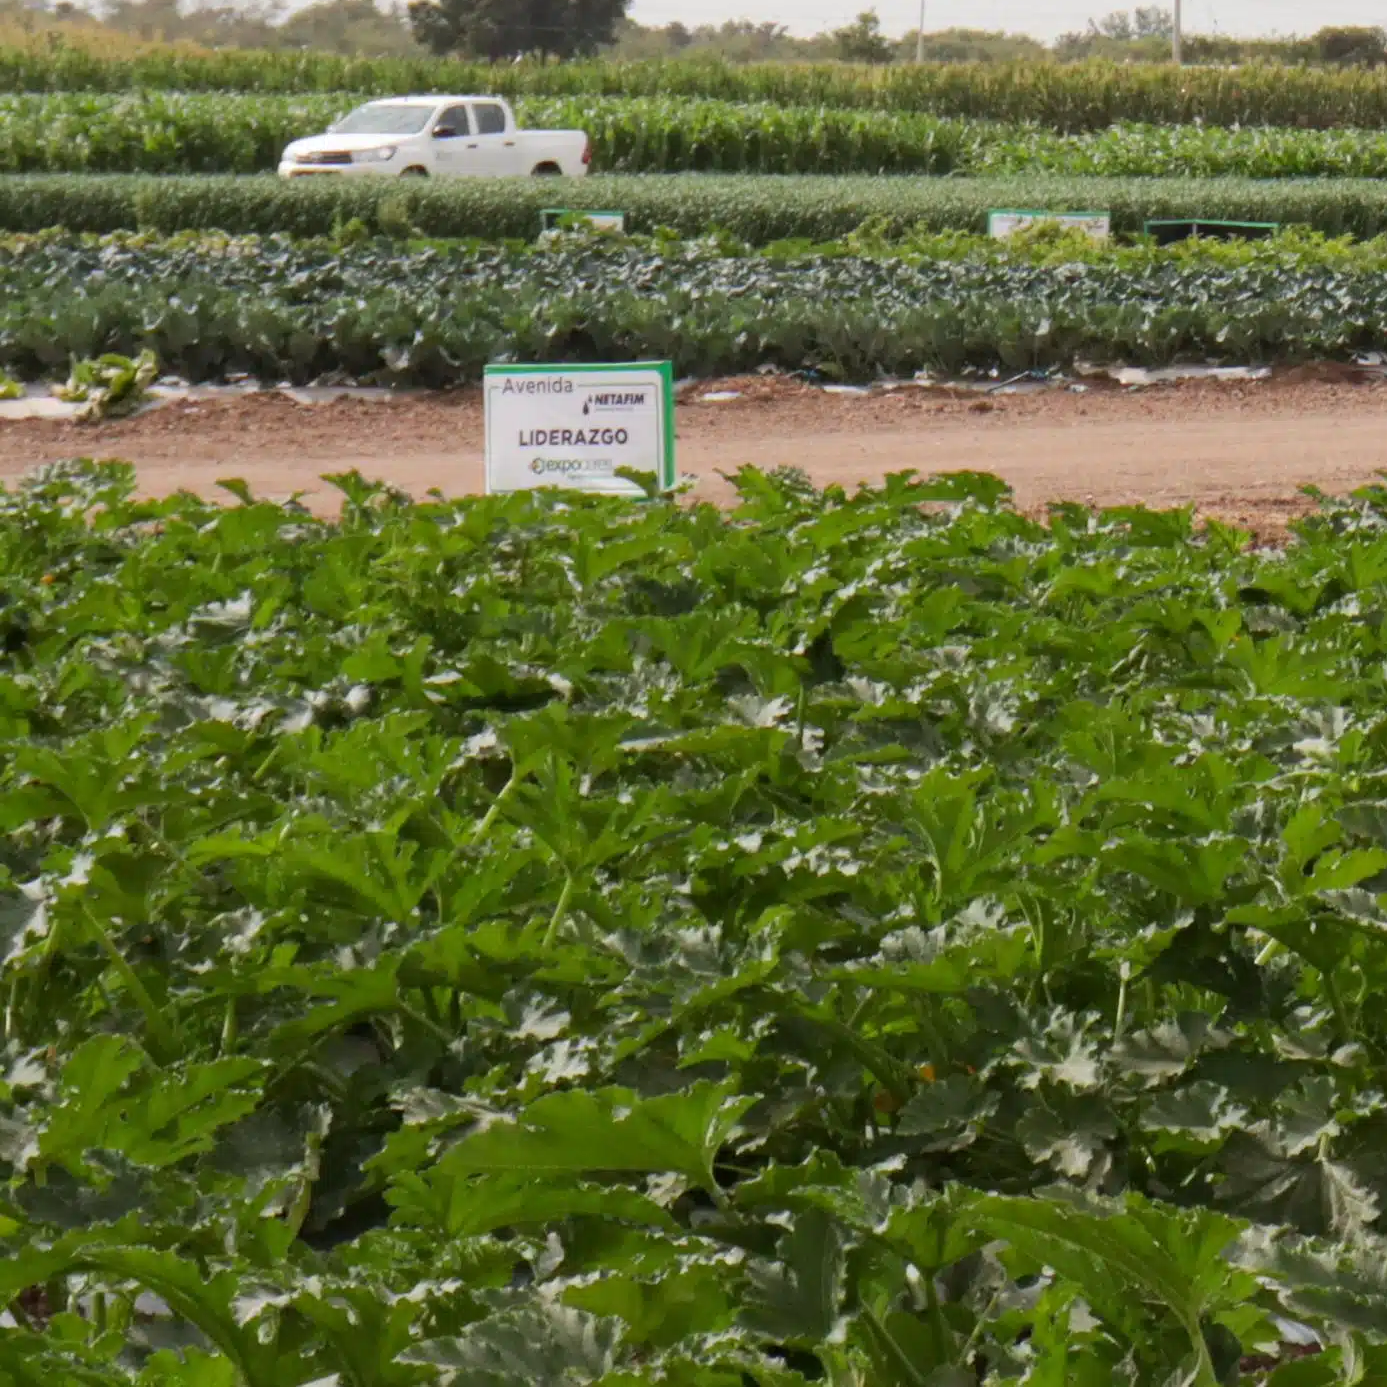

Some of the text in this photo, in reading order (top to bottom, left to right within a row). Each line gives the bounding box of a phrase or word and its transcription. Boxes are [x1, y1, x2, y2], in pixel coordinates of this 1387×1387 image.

[502, 376, 574, 395] Avenida
[594, 392, 645, 406] NETAFIM
[518, 428, 628, 447] LIDERAZGO
